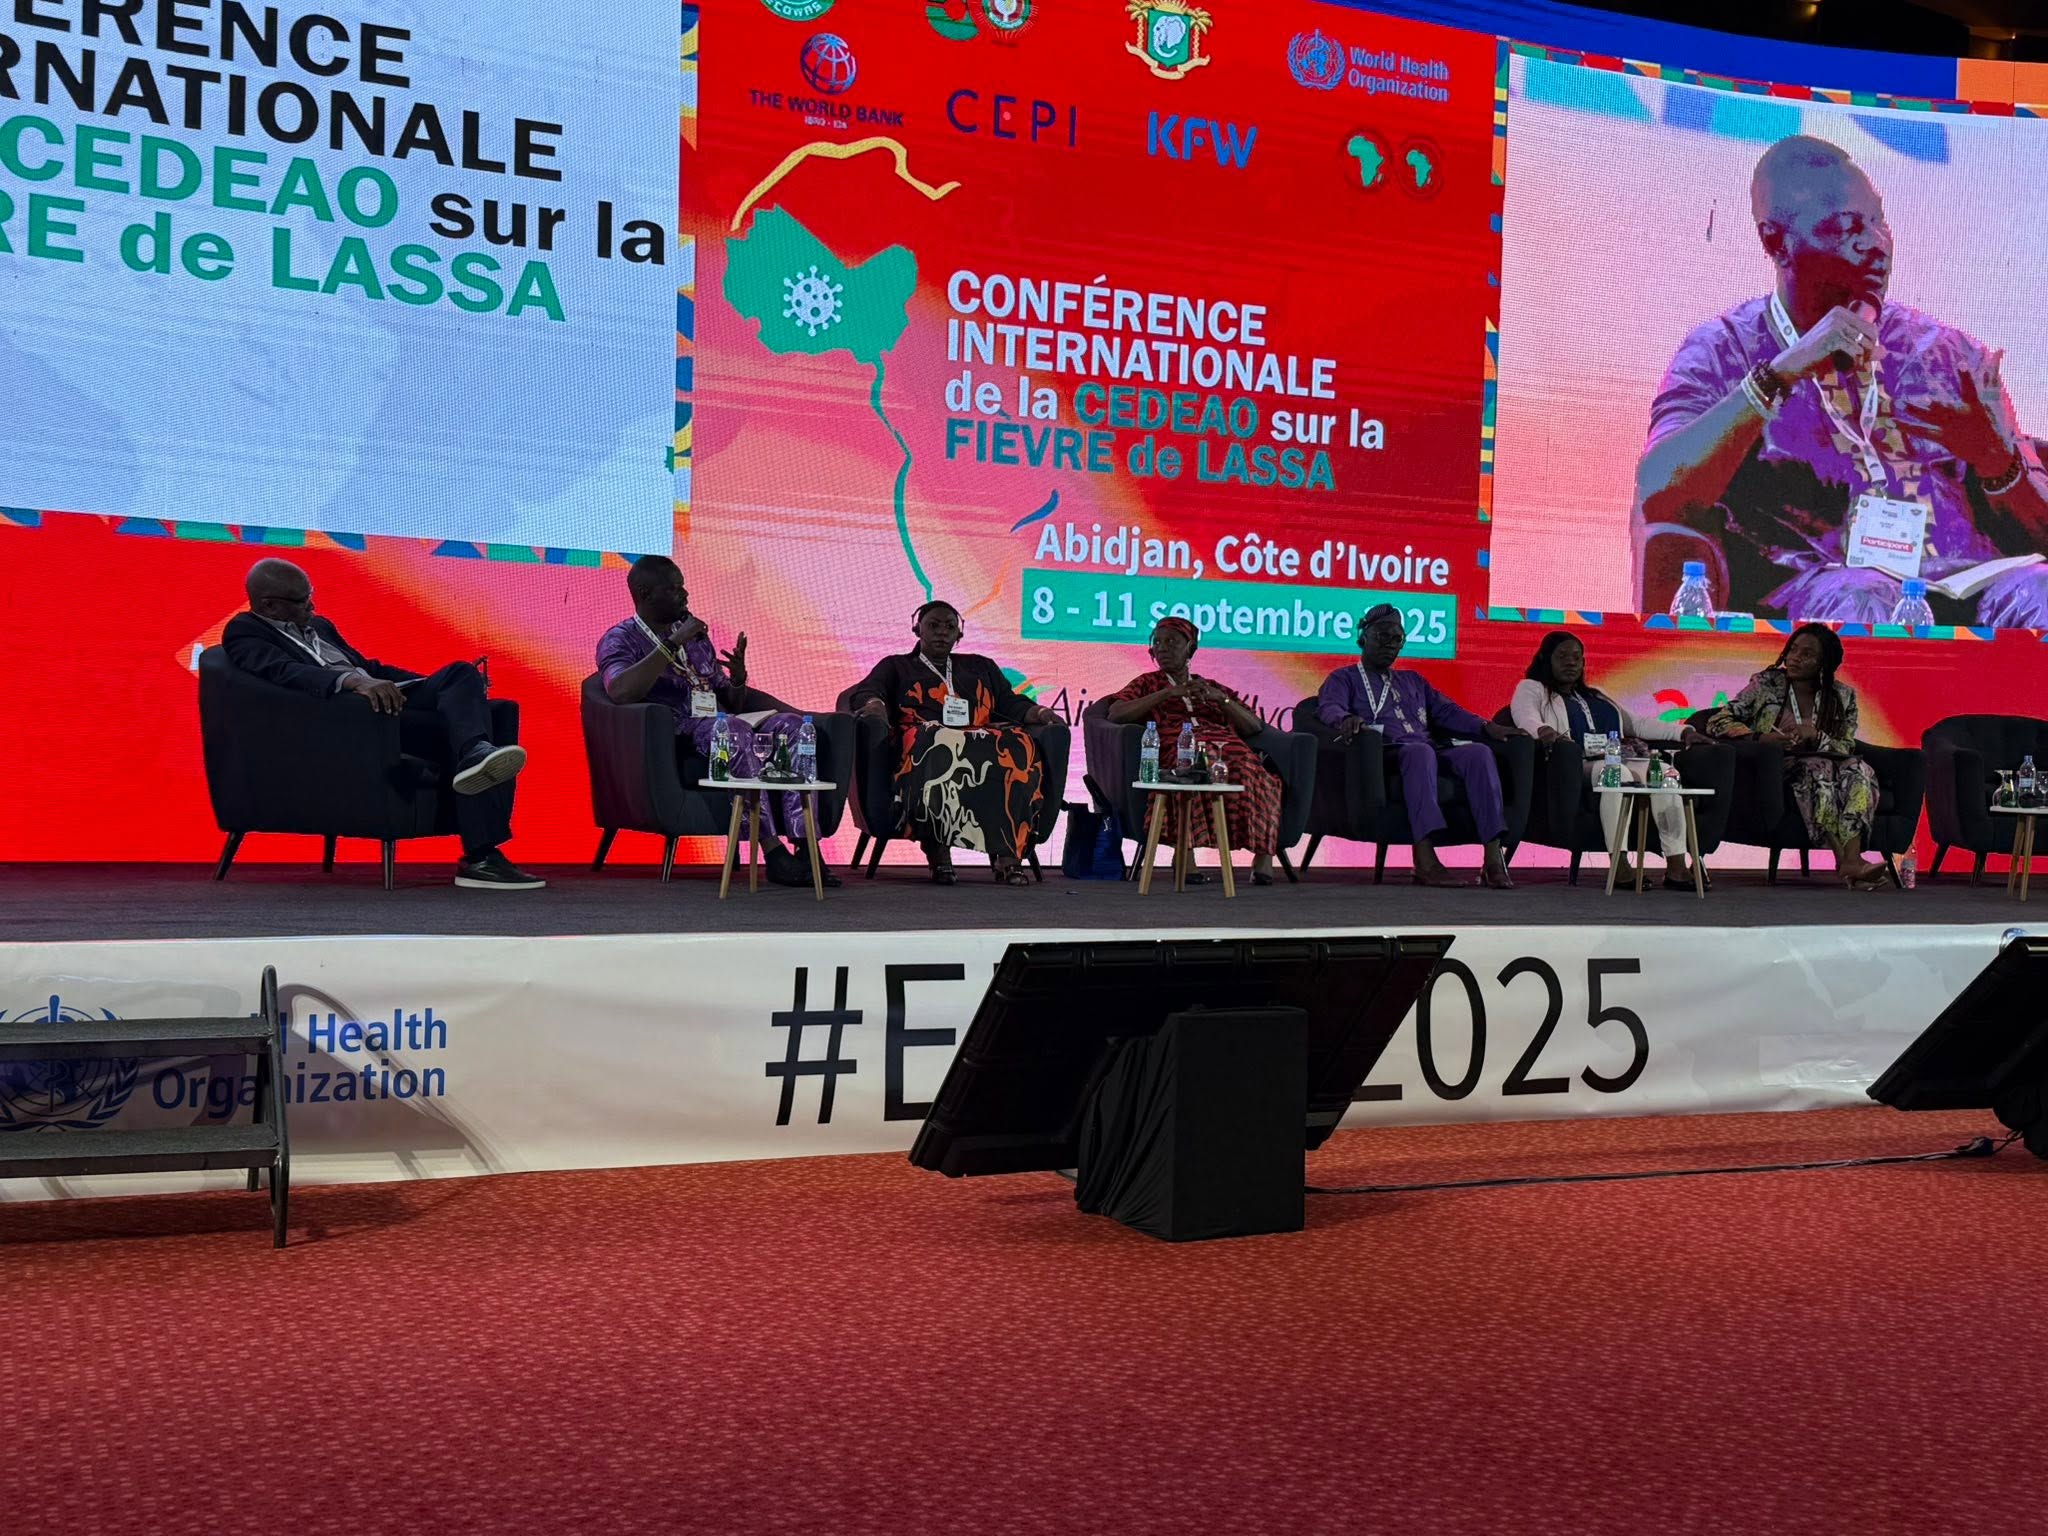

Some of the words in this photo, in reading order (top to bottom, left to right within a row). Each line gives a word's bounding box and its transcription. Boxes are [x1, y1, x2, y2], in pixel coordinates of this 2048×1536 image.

[1349, 69, 1449, 102] Organization
[1350, 47, 1394, 71] World
[1400, 55, 1450, 80] Health
[749, 90, 782, 109] THE
[788, 96, 851, 119] WORLD
[856, 105, 904, 126] BANK
[946, 89, 1077, 147] CEPI
[0, 115, 399, 228] CEDEAO
[429, 193, 565, 252] sur
[597, 200, 666, 266] la
[120, 211, 234, 281] de
[271, 227, 566, 322] LASSA
[947, 270, 1267, 346] CONFÉRENCE
[946, 319, 1337, 399] INTERNATIONALE
[945, 370, 1003, 415] de
[1018, 377, 1058, 420] la
[1073, 382, 1259, 438] CEDEAO
[1271, 409, 1337, 446] sur
[1350, 409, 1385, 450] la
[945, 411, 1116, 475] FIÈVRE
[1128, 434, 1182, 479] de
[1197, 439, 1336, 491] LASSA
[1034, 522, 1204, 579] Abidjan,
[1215, 534, 1300, 577] Côte
[1031, 586, 1055, 624] 8
[1092, 592, 1137, 628] 11
[308, 1008, 447, 1053] Health
